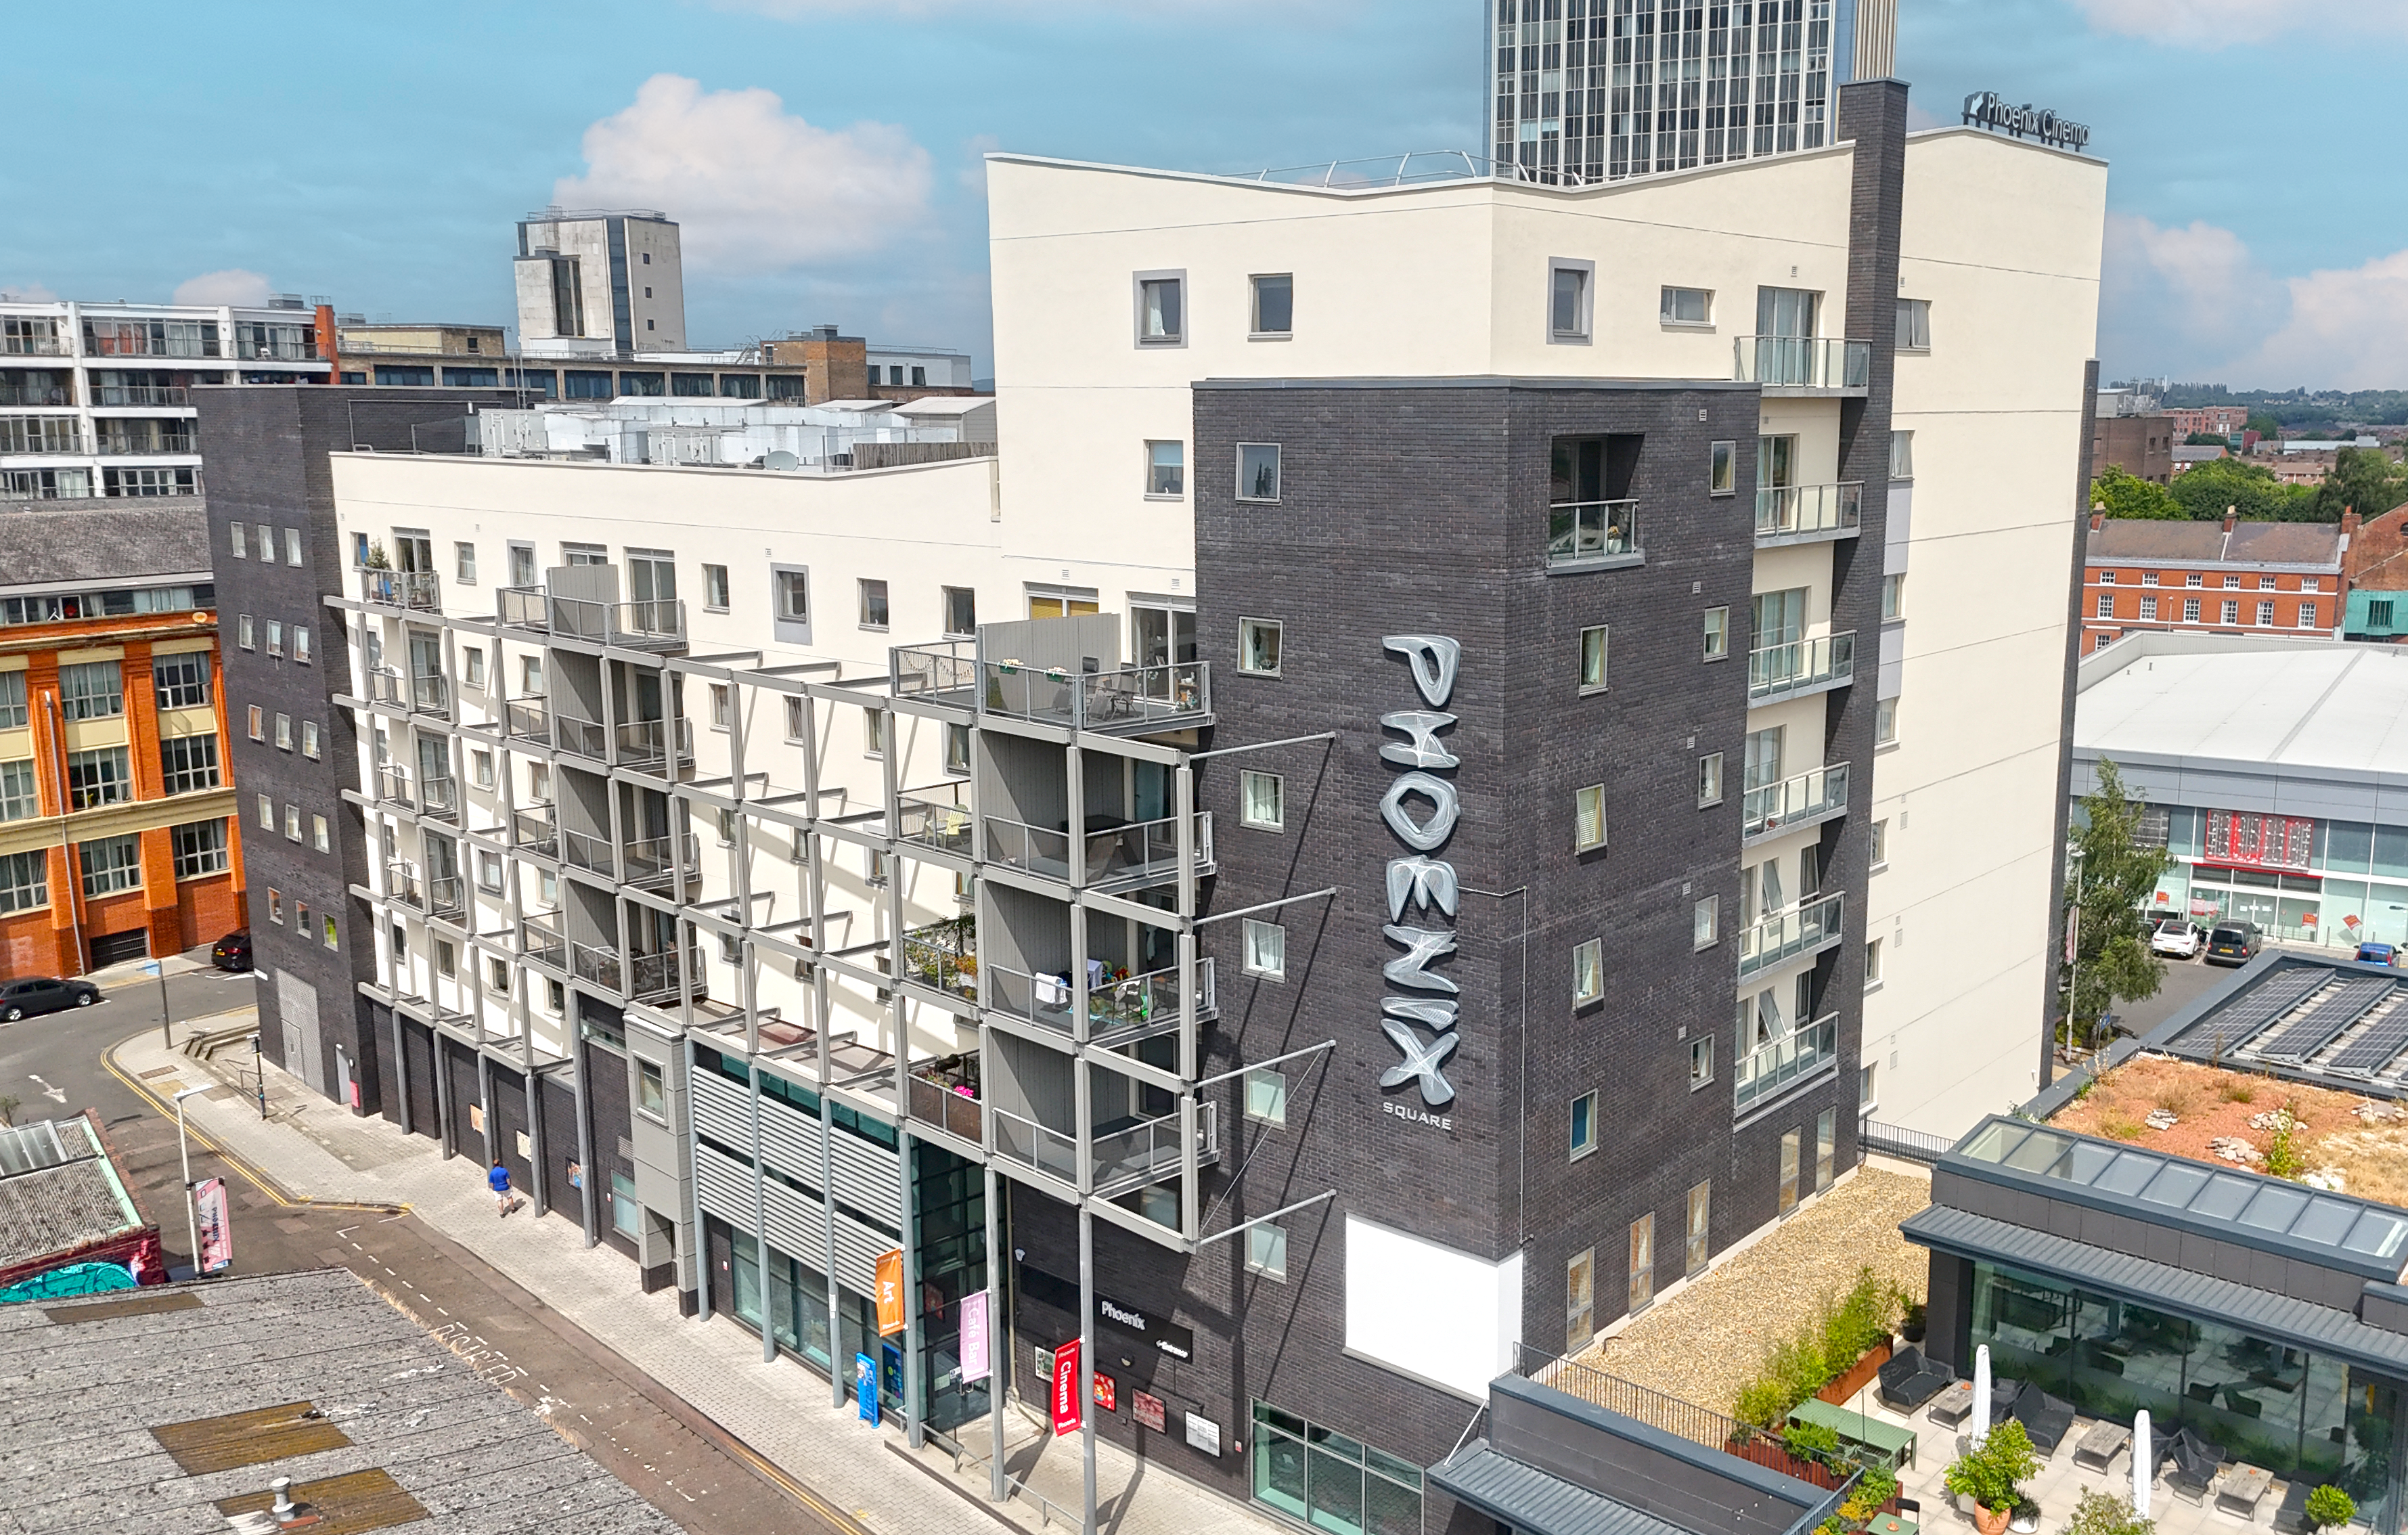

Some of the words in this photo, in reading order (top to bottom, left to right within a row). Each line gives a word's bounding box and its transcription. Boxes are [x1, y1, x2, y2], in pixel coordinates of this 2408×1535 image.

[1987, 92, 2039, 134] Phoenix
[2043, 109, 2090, 145] Cinema
[1379, 634, 1461, 1105] PHOENIX
[1383, 1101, 1452, 1131] SQUARE
[883, 1281, 895, 1304] Art
[968, 1307, 981, 1339] Café
[1101, 1300, 1146, 1331] Phoenix
[968, 1341, 980, 1365] Bar
[1059, 1360, 1072, 1415] Cinema
